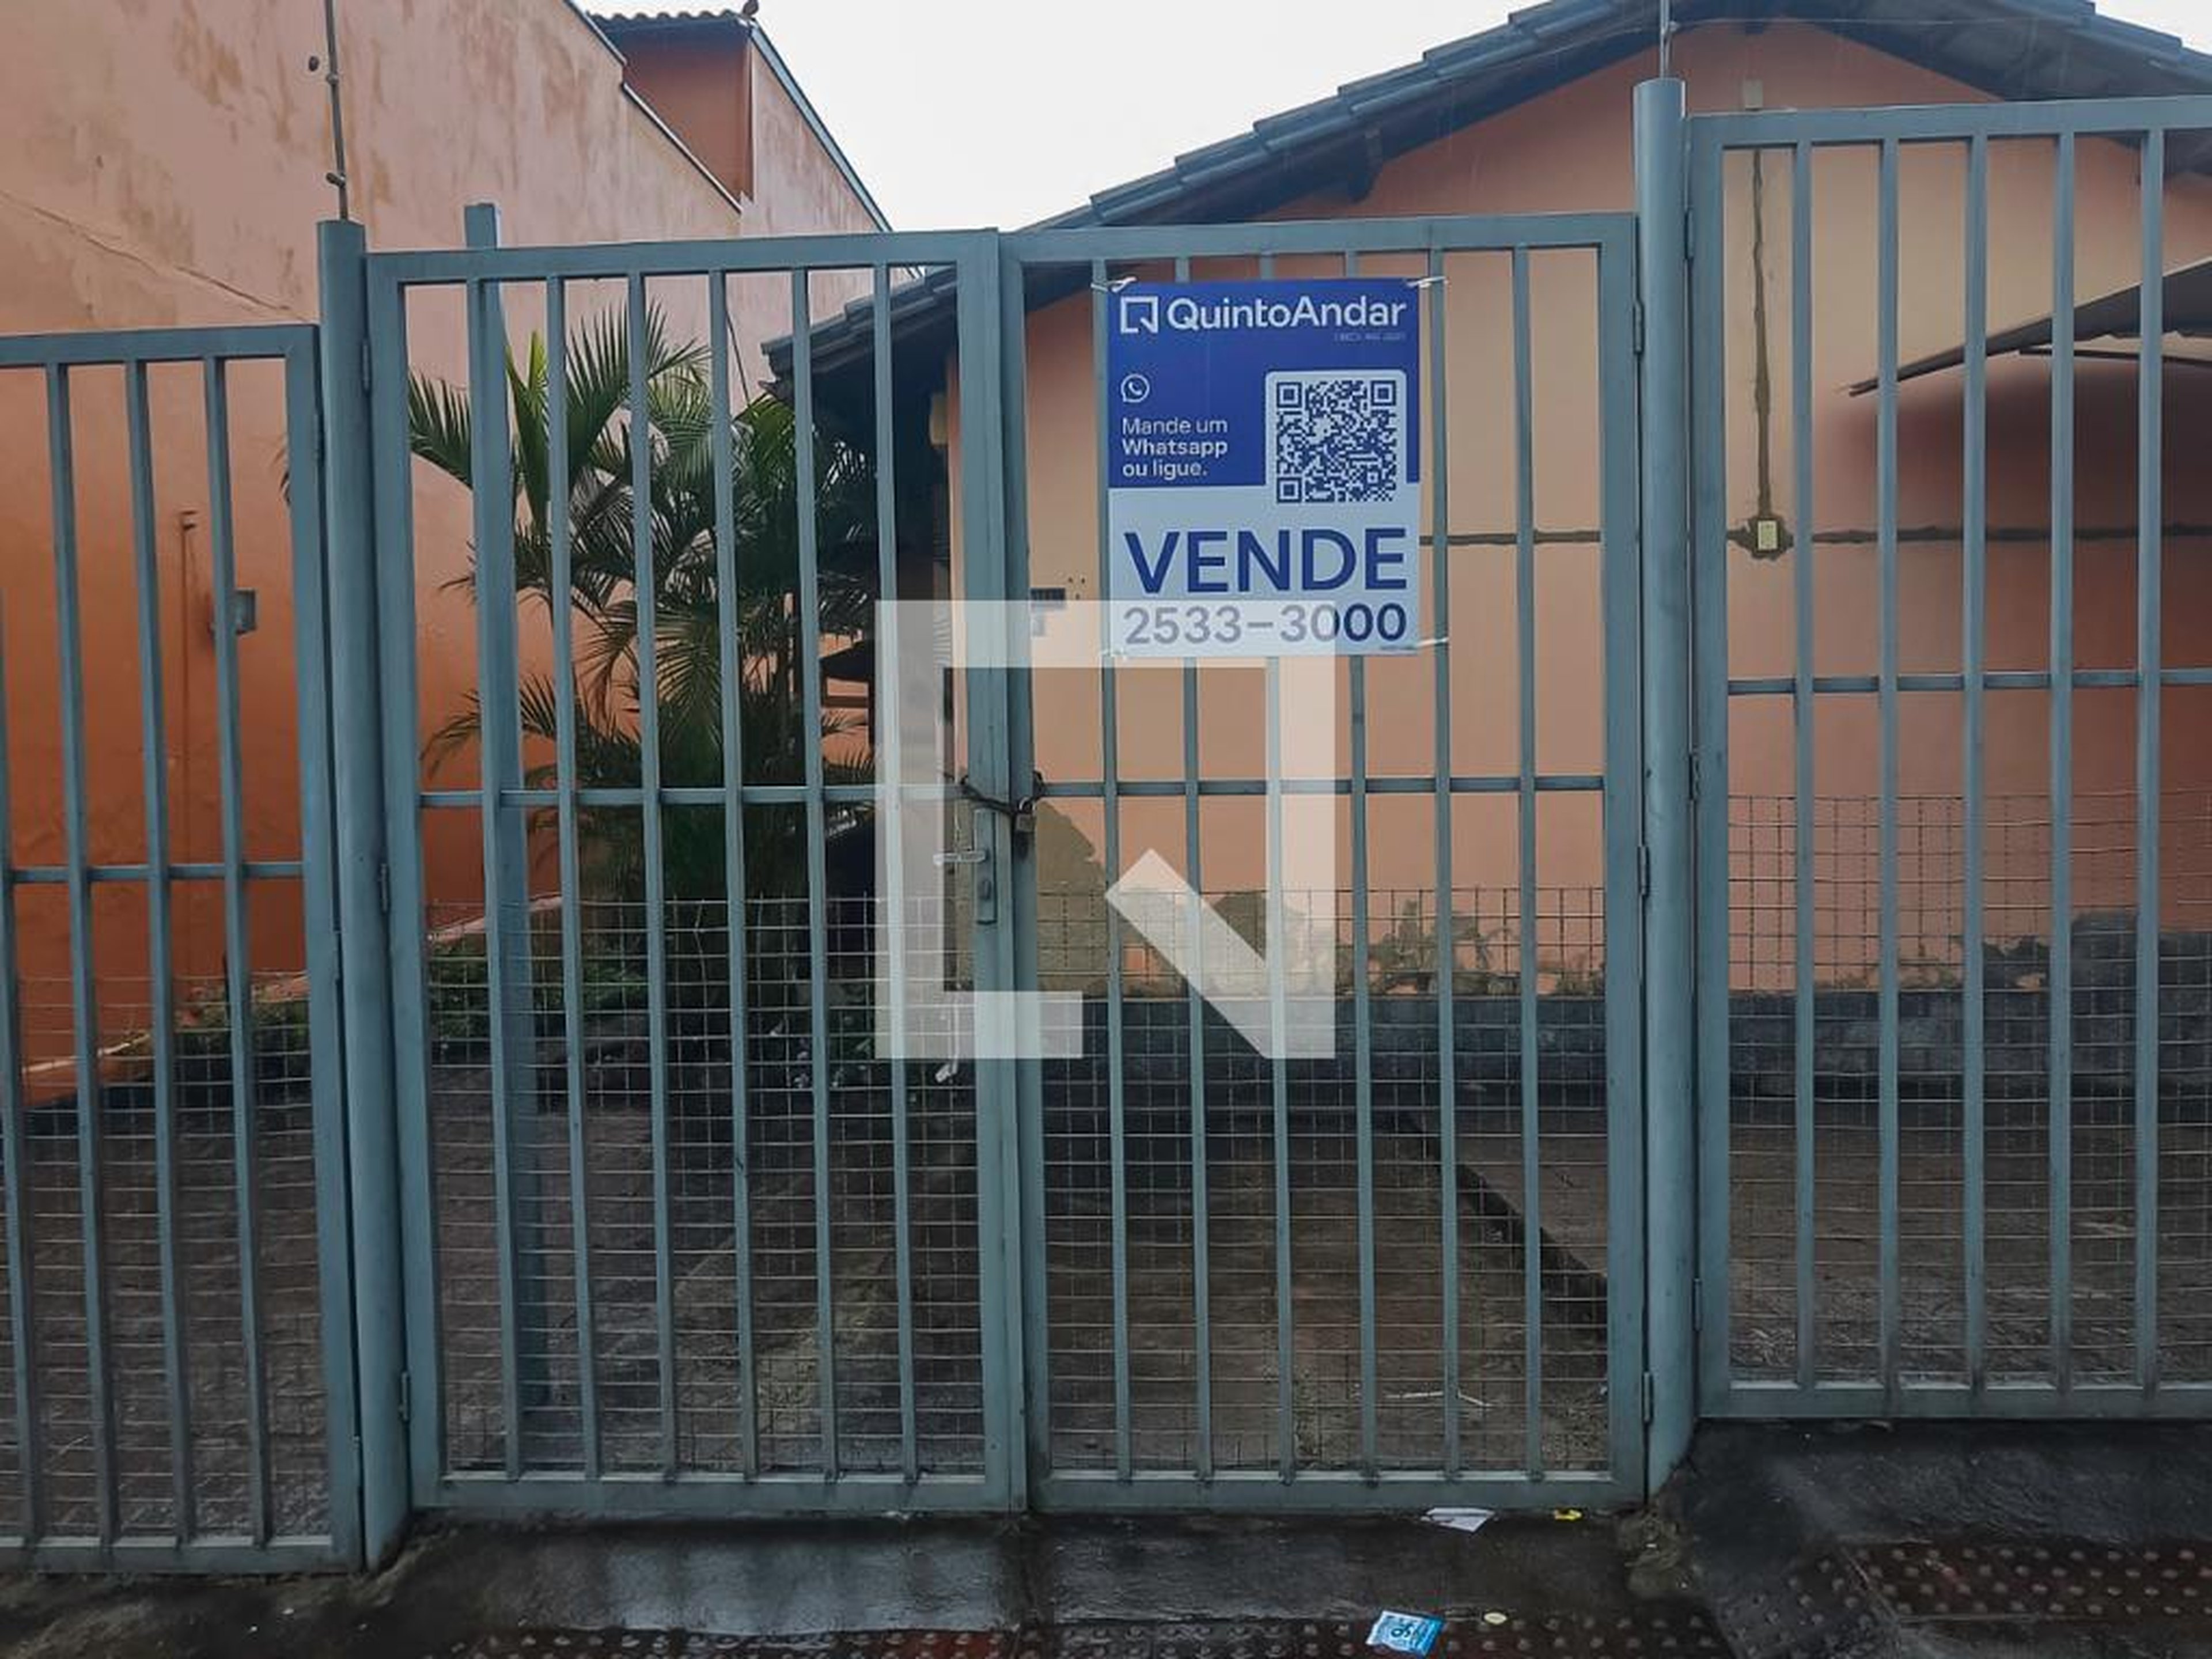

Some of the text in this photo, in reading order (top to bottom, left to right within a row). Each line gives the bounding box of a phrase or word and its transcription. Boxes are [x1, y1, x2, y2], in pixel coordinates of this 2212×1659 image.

[1166, 296, 1406, 330] QuintoAndar
[1123, 417, 1228, 434] Mande um
[1122, 438, 1228, 458] Whatsapp
[1123, 459, 1207, 480] ou ligue.
[1124, 528, 1407, 593] VENDE
[1123, 603, 1407, 644] 2533-3000
